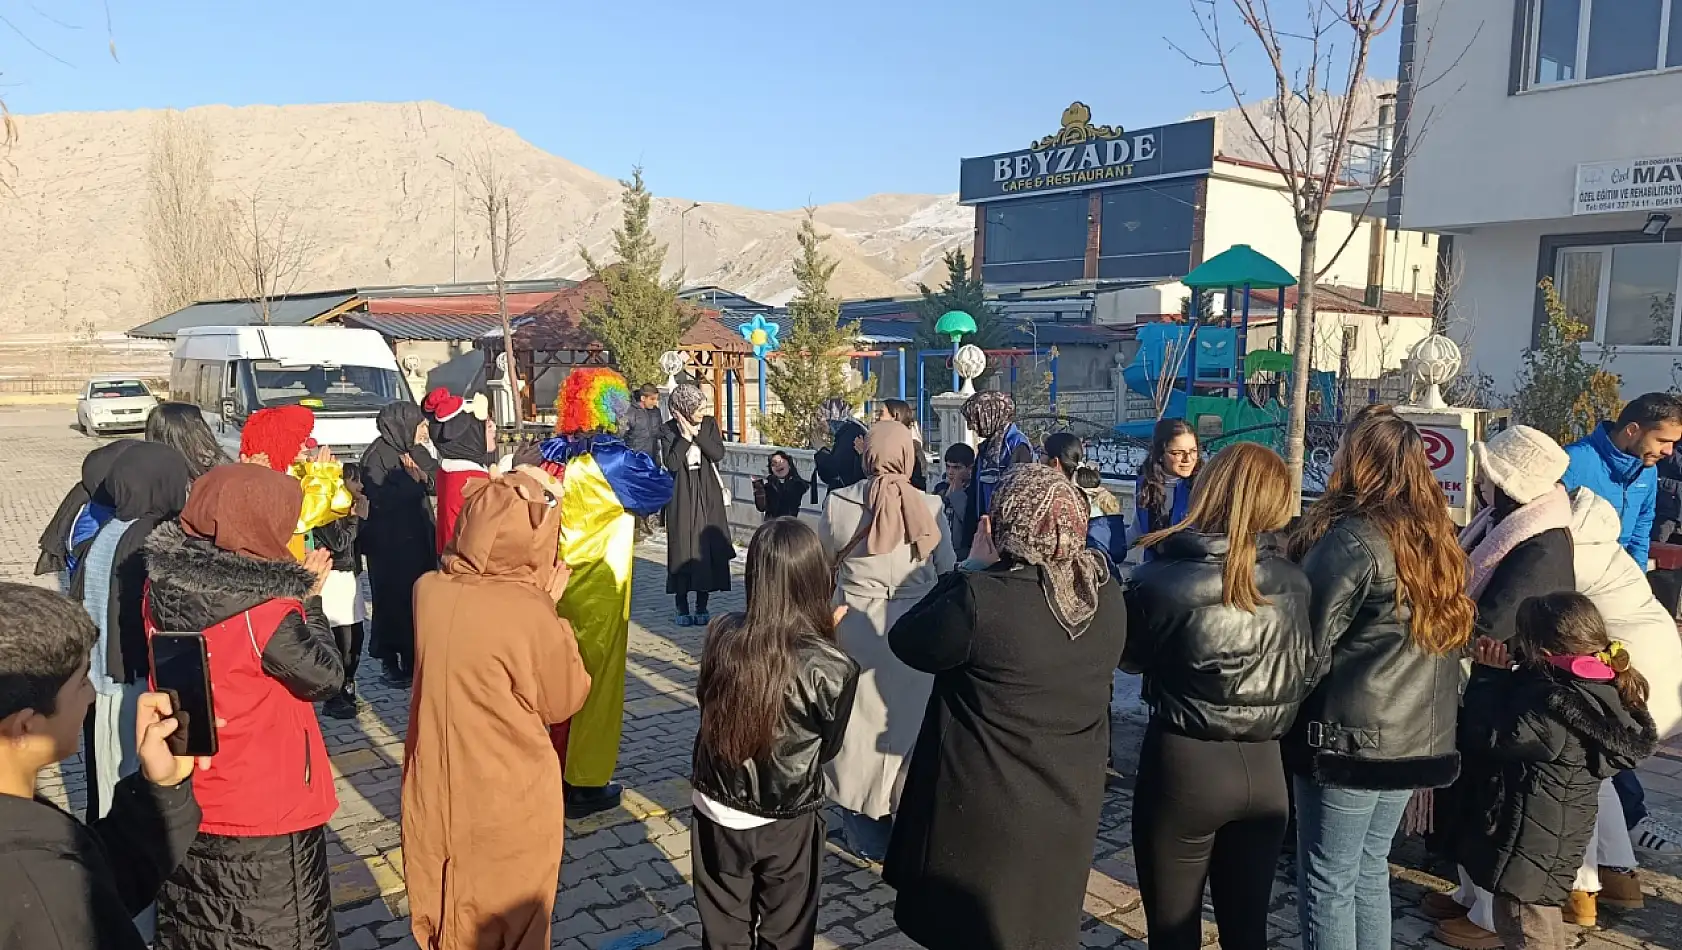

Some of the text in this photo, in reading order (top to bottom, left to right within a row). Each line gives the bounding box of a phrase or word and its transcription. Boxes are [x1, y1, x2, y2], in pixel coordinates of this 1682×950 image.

[993, 133, 1156, 182] BEYZADE
[1002, 164, 1134, 192] CAFE & RESTAURANT
[1620, 188, 1629, 198] VE
[1630, 184, 1682, 198] REHABİLİTASYO
